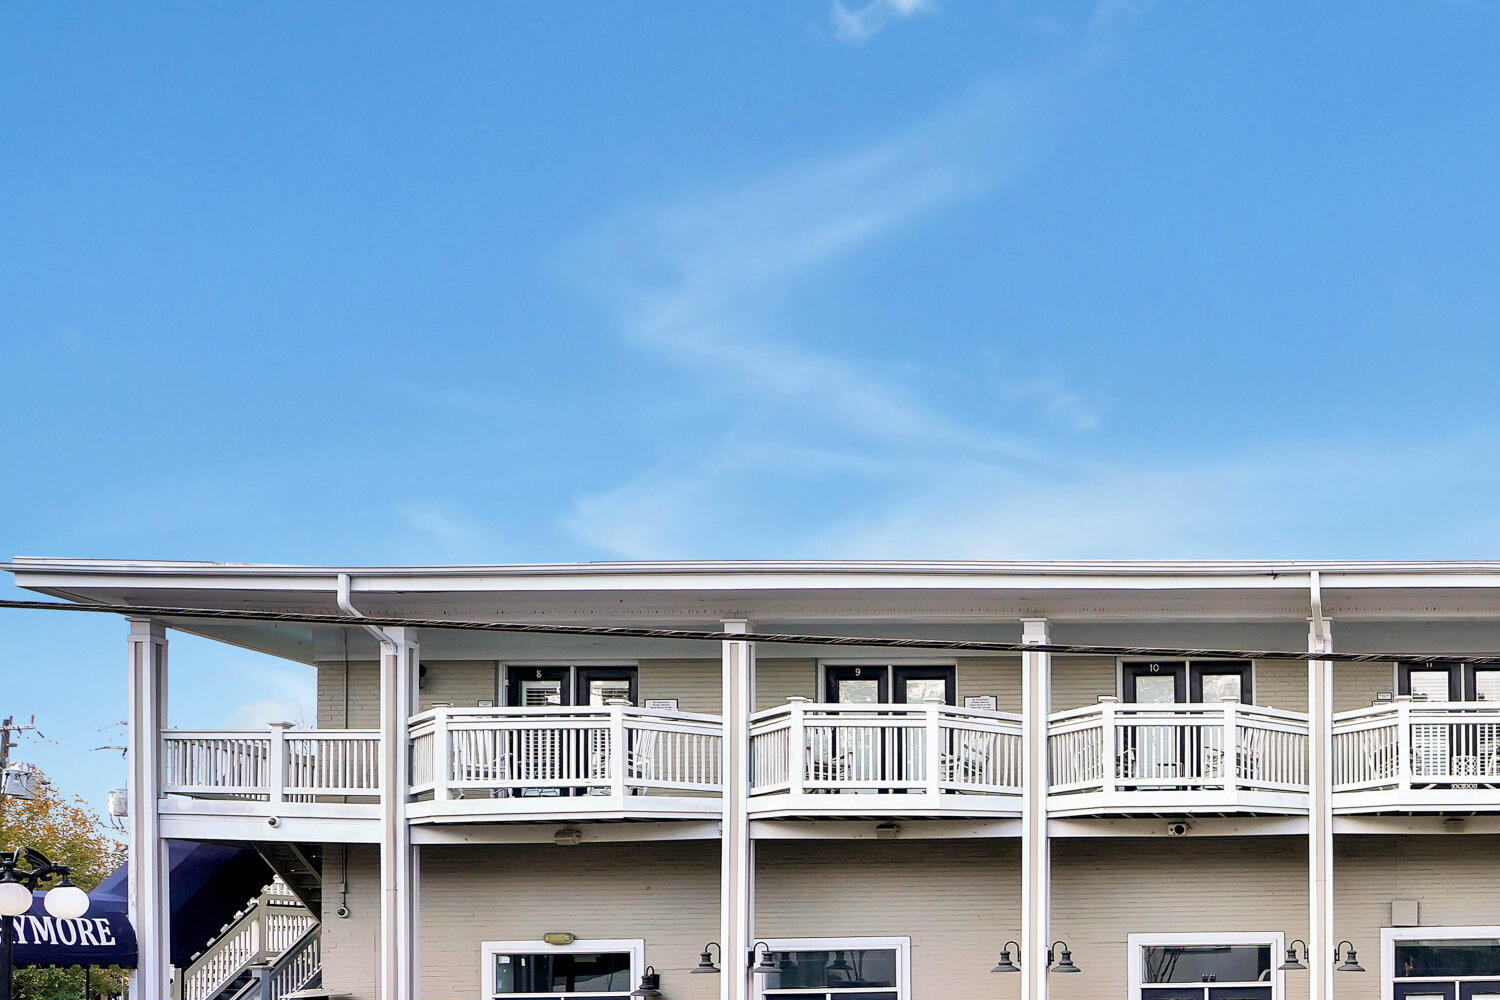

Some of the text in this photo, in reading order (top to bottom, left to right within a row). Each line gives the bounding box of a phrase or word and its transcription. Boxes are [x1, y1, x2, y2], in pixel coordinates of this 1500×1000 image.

[855, 667, 861, 677] 9
[1149, 663, 1160, 673] 10
[536, 669, 542, 679] 8
[0, 914, 116, 946] YMORE
